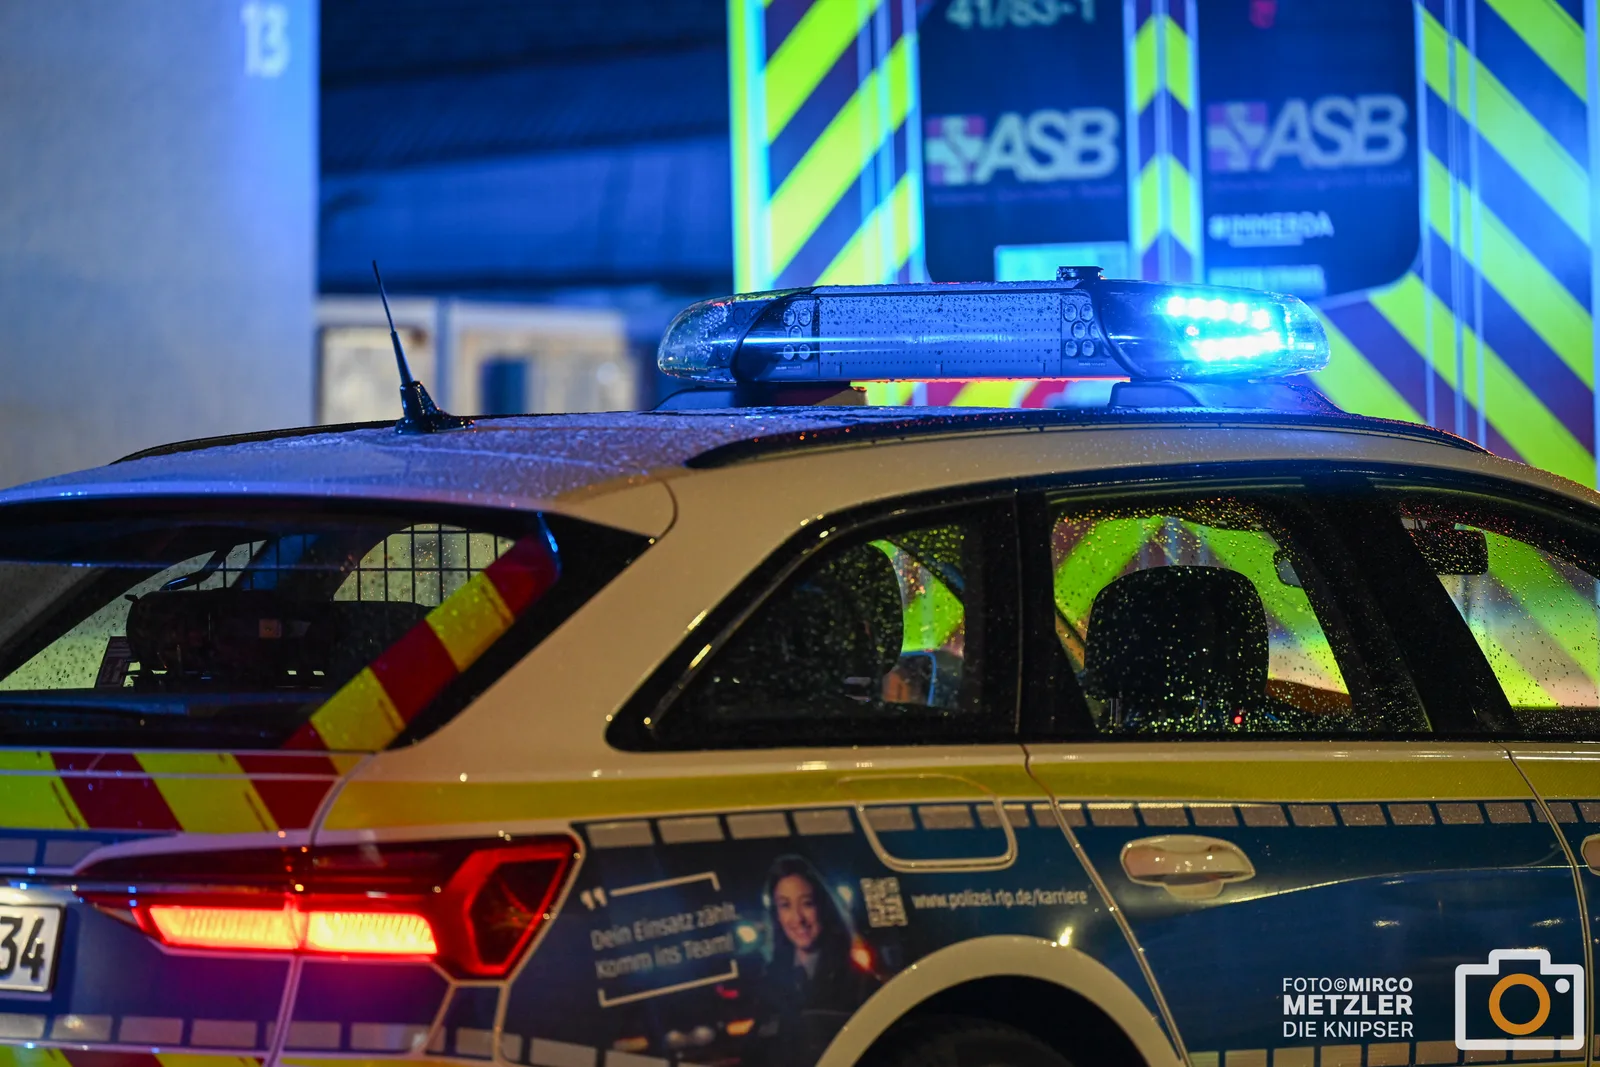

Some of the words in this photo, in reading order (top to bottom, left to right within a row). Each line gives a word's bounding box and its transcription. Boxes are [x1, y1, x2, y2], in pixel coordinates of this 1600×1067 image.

[241, 2, 291, 77] 13
[974, 107, 1119, 184] ASB
[1257, 93, 1408, 171] ASB
[590, 924, 633, 951] Dein
[633, 912, 695, 942] Einsatz
[911, 887, 1088, 910] www.polizei.rlp.de/karriere
[0, 915, 45, 983] 34
[594, 952, 653, 979] Komm
[653, 943, 683, 967] ins
[682, 931, 735, 960] Team!
